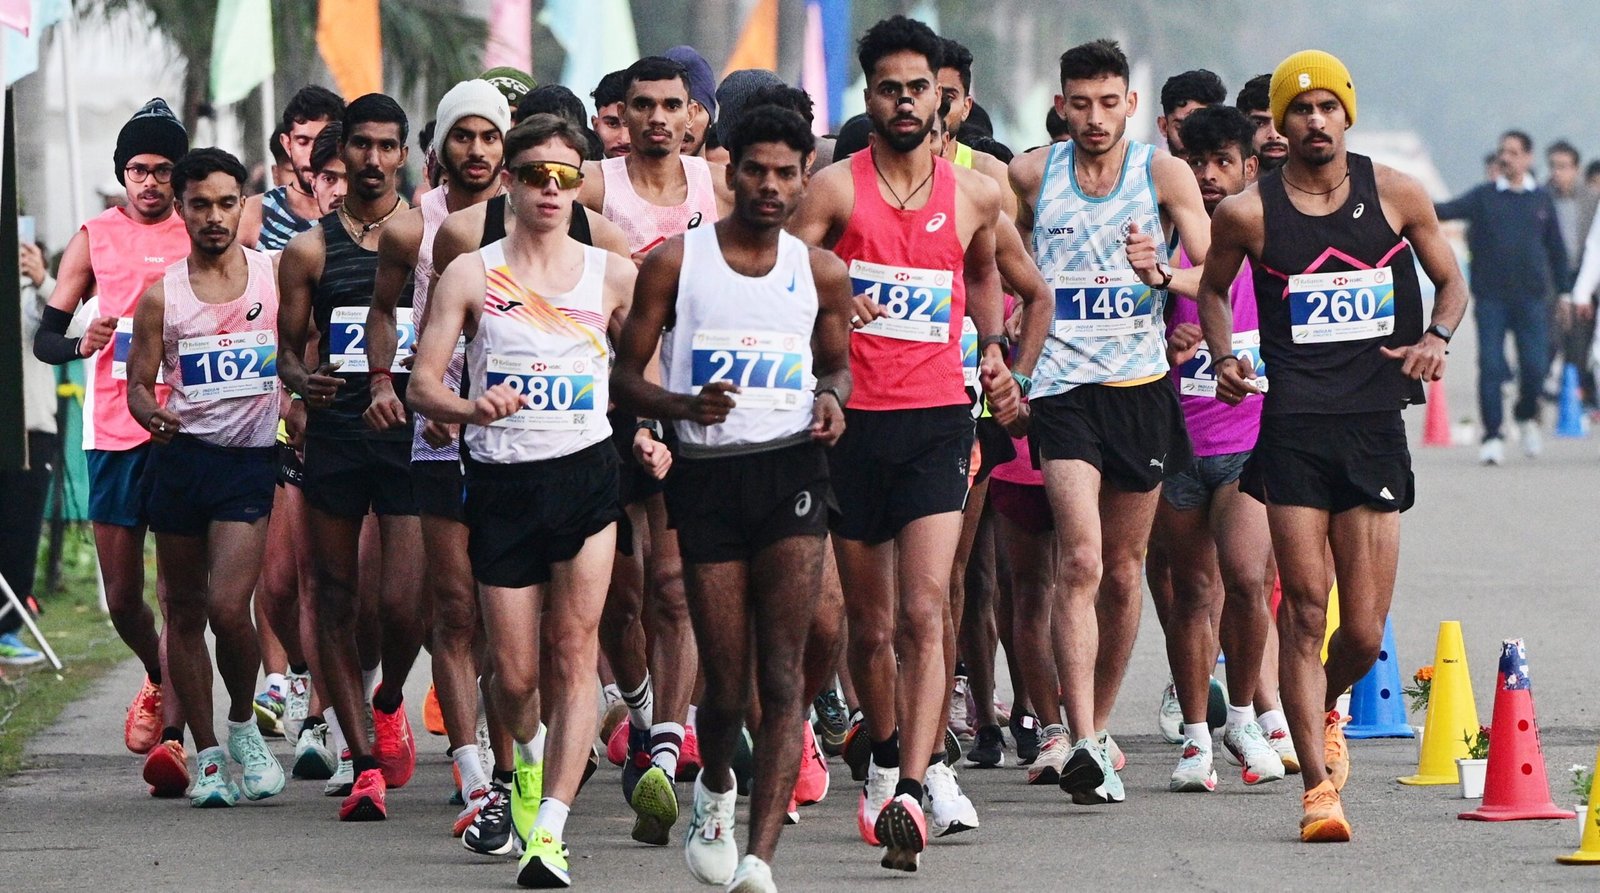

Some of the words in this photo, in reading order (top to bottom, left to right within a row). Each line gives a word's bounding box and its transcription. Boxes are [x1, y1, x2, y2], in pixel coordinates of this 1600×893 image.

[1048, 227, 1074, 235] VATS
[864, 282, 934, 321] 182
[1072, 287, 1135, 319] 146
[1306, 288, 1376, 325] 260
[196, 348, 260, 383] 162
[708, 350, 784, 388] 277
